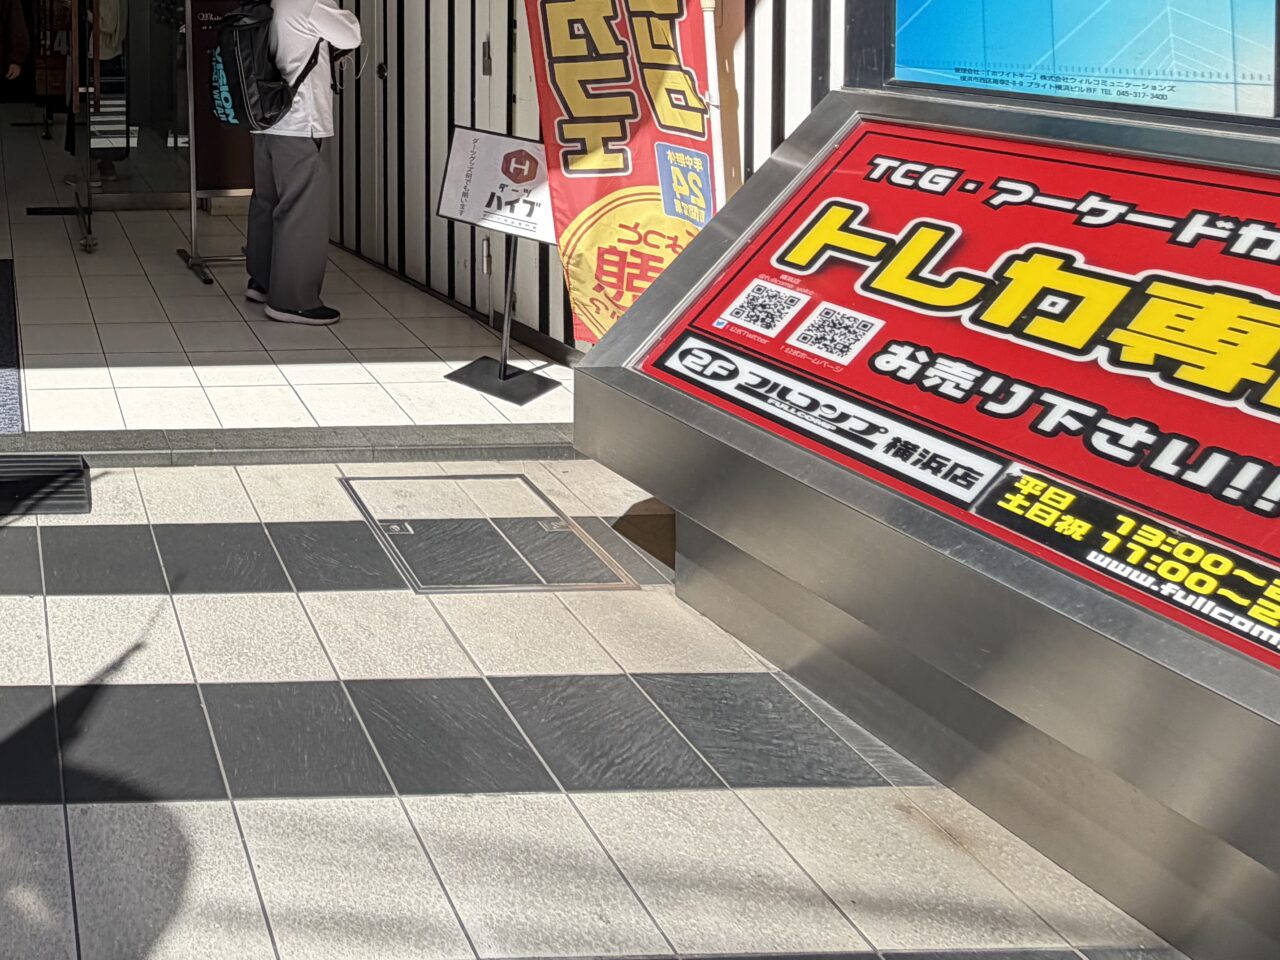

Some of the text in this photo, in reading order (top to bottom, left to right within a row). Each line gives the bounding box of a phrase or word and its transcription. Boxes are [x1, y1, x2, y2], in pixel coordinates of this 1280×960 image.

[484, 191, 542, 218] ハイブ
[780, 202, 1280, 412] トレカ専
[688, 348, 736, 377] 2F
[767, 397, 838, 431] FULLCOMP
[882, 436, 986, 490] 横浜店
[1014, 474, 1078, 511] 平日
[996, 492, 1094, 541] 土日祝
[1086, 551, 1280, 650] www.fullcom
